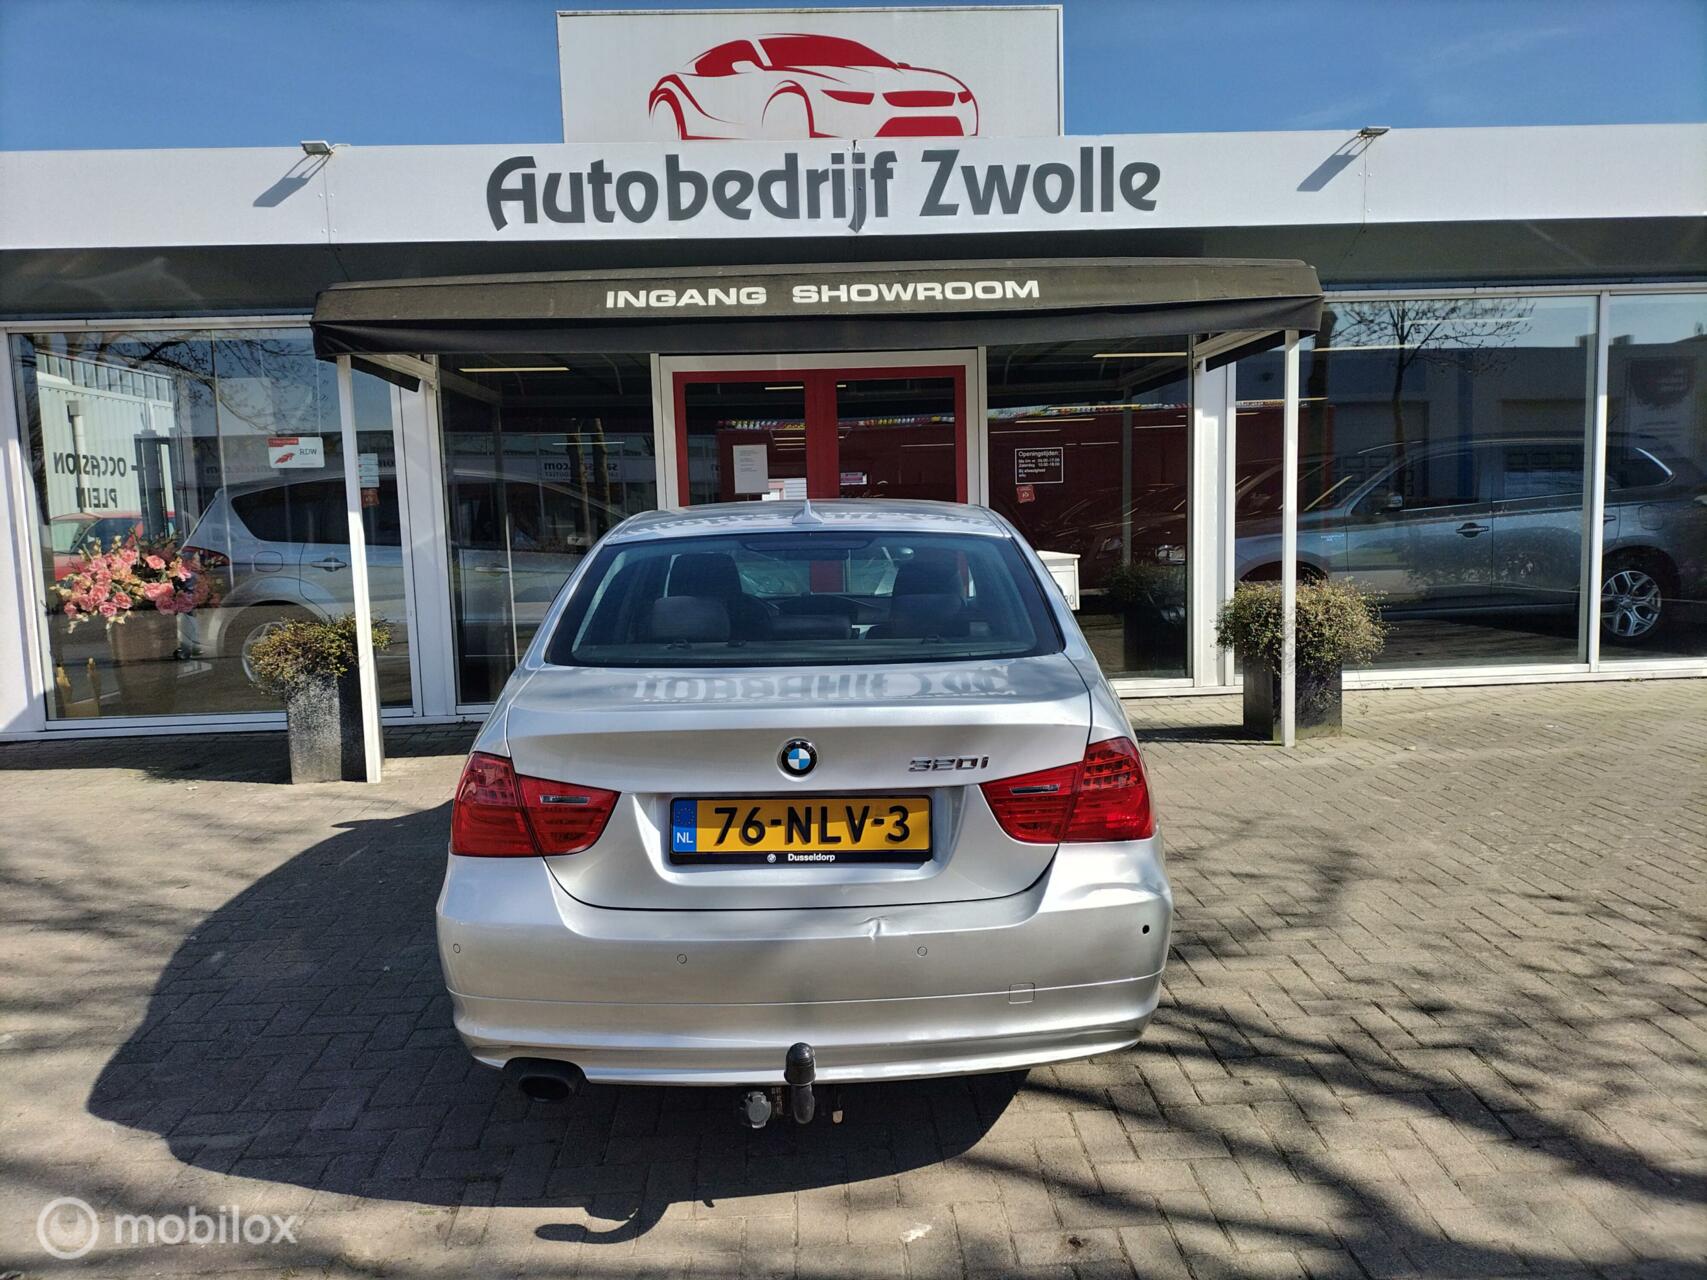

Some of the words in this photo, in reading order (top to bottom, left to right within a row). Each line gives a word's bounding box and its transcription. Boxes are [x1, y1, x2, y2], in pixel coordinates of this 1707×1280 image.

[486, 151, 898, 233] Autobedrijf
[919, 146, 1161, 216] Zwolle
[605, 286, 768, 310] INGANG
[791, 280, 1040, 304] SHOWROOM
[907, 756, 989, 773] 320i
[714, 804, 911, 845] 76-NLV-3
[676, 831, 694, 844] NL
[787, 853, 836, 862] Dusseldorp
